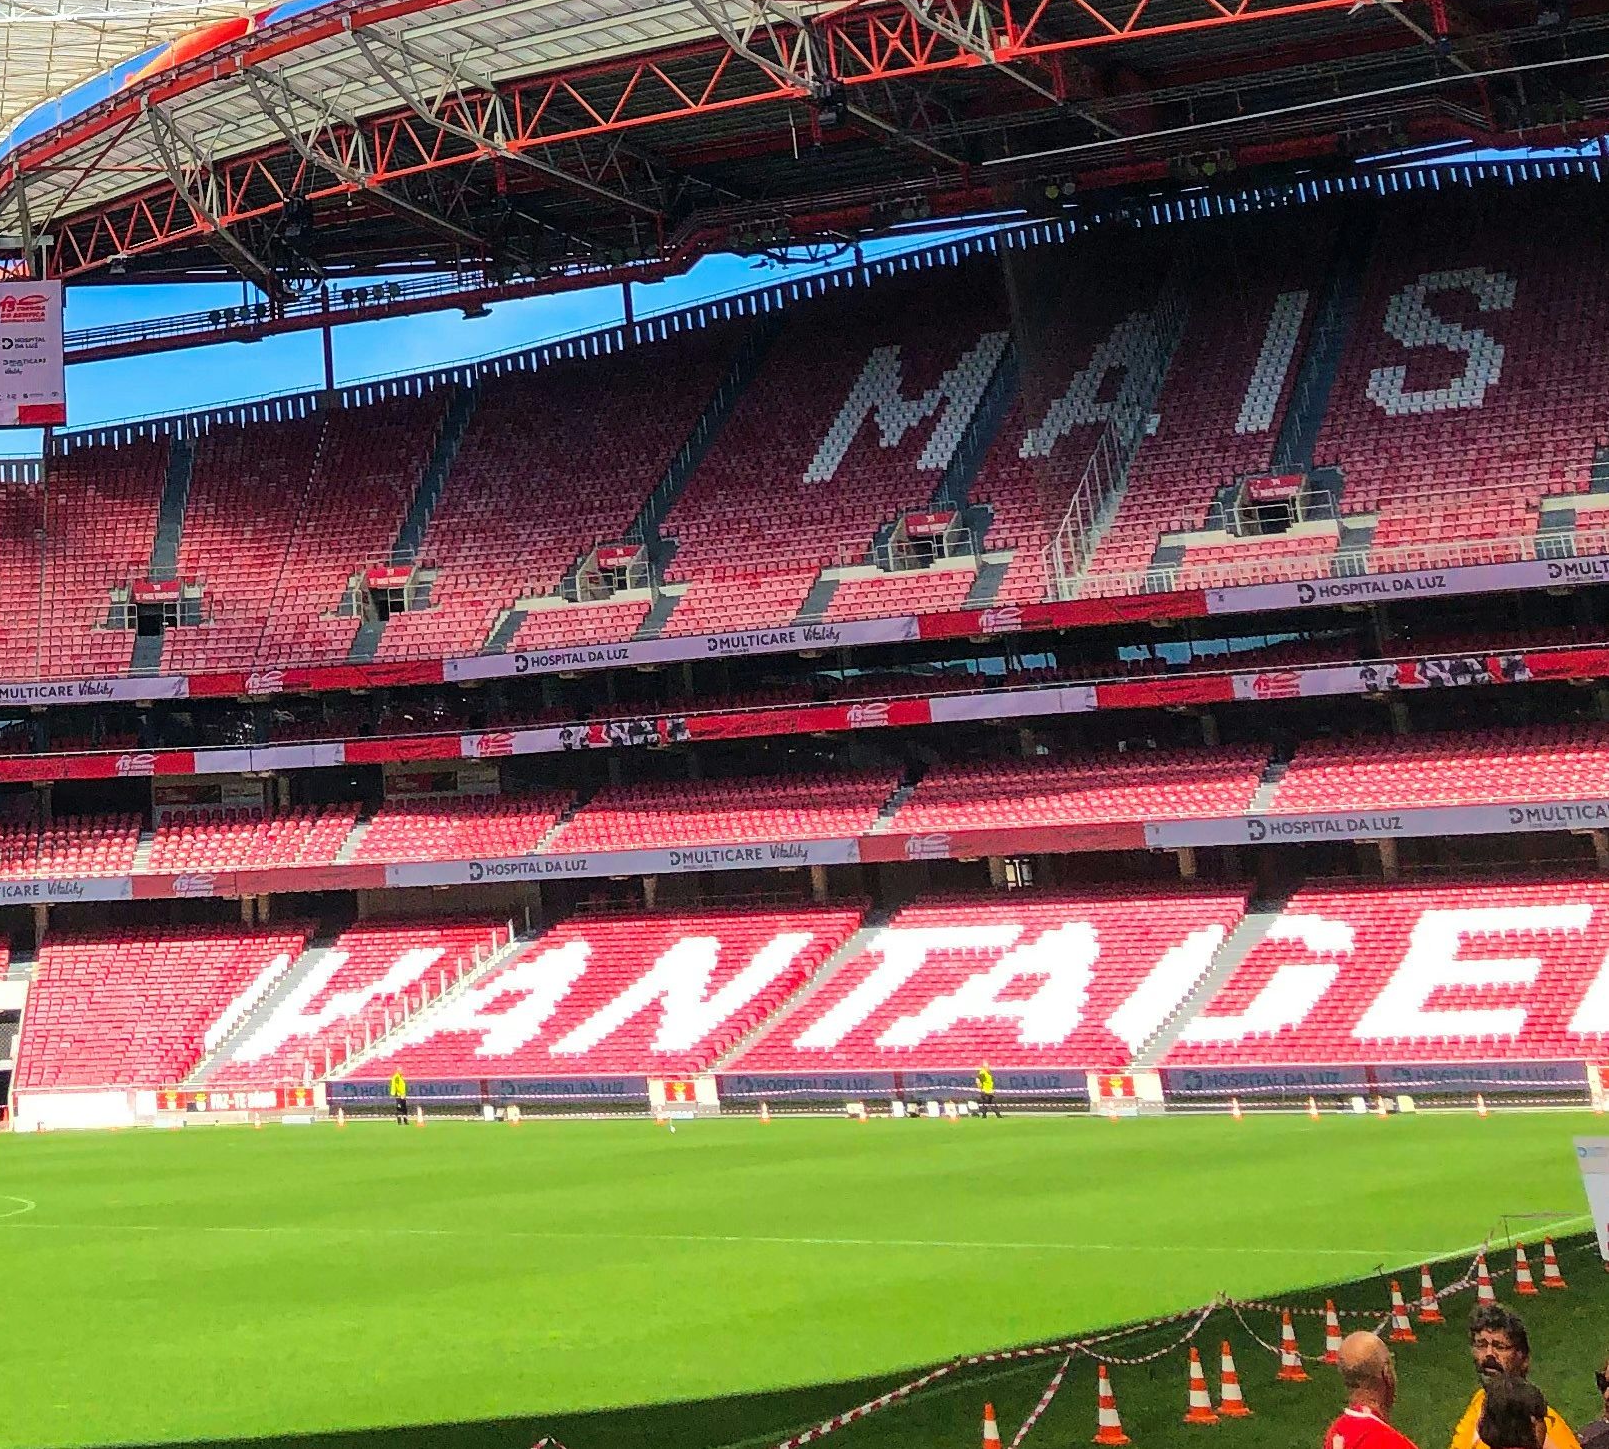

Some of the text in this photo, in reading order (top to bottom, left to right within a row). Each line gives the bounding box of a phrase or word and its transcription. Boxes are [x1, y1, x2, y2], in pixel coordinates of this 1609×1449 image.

[803, 266, 1518, 484] MAIS
[1319, 576, 1446, 597] HOSPITAL DA LUZ
[720, 626, 840, 649] MULTICARE Vitality
[531, 649, 629, 667] HOSPITAL DA LUZ
[0, 682, 114, 699] MULTICARE Vitality
[1527, 805, 1609, 822] MULTICA
[1270, 816, 1403, 835] HOSPITAL DA LUZ
[682, 844, 808, 863] MULTICARE Vitality
[486, 860, 588, 875] HOSPITAL DA LUZ
[47, 881, 83, 898] Vitality
[206, 905, 1609, 1067] VANTAGE
